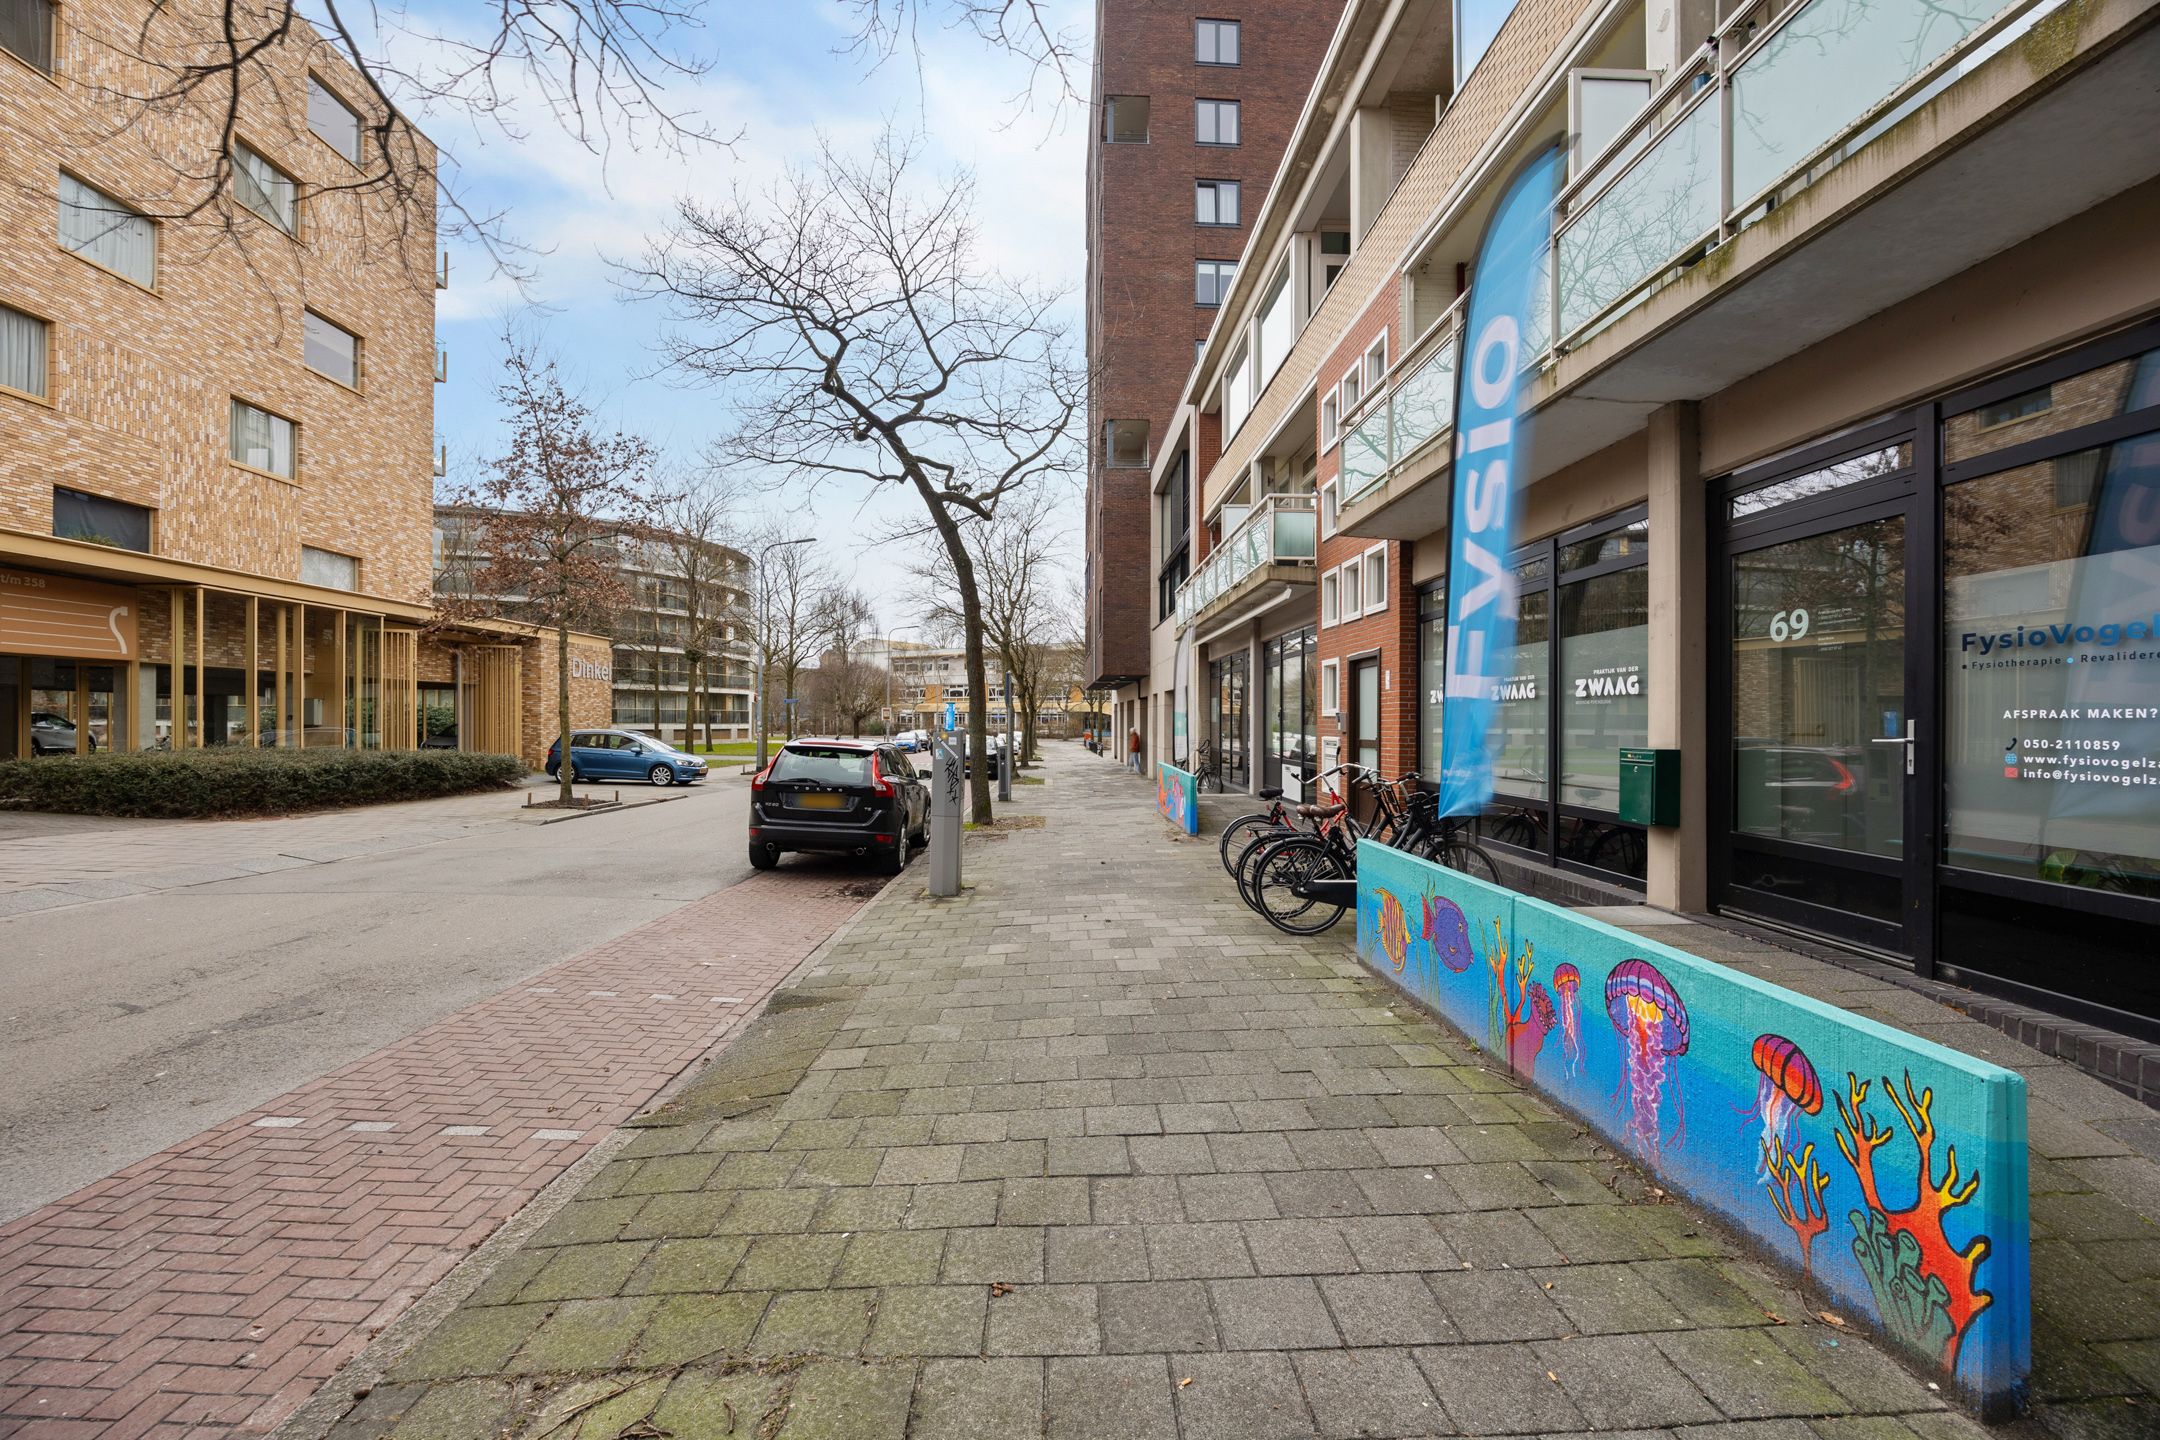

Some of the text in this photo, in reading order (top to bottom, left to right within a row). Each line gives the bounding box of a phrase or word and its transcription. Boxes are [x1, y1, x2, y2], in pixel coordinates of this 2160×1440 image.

[24, 576, 46, 588] 358
[1770, 608, 1809, 642] 69
[1961, 613, 2160, 655] FysioVogel
[572, 656, 613, 681] Dinkel
[1972, 656, 2062, 670] Fysiotherapie
[1491, 682, 1536, 701] ZWAAG
[1575, 675, 1639, 697] ZWAAG
[2003, 708, 2159, 719] AFSPRAAK MAKEN?
[2023, 739, 2121, 751] 050-2110859
[2023, 768, 2160, 786] info@fysiovogelz
[794, 785, 843, 793] VOLVO
